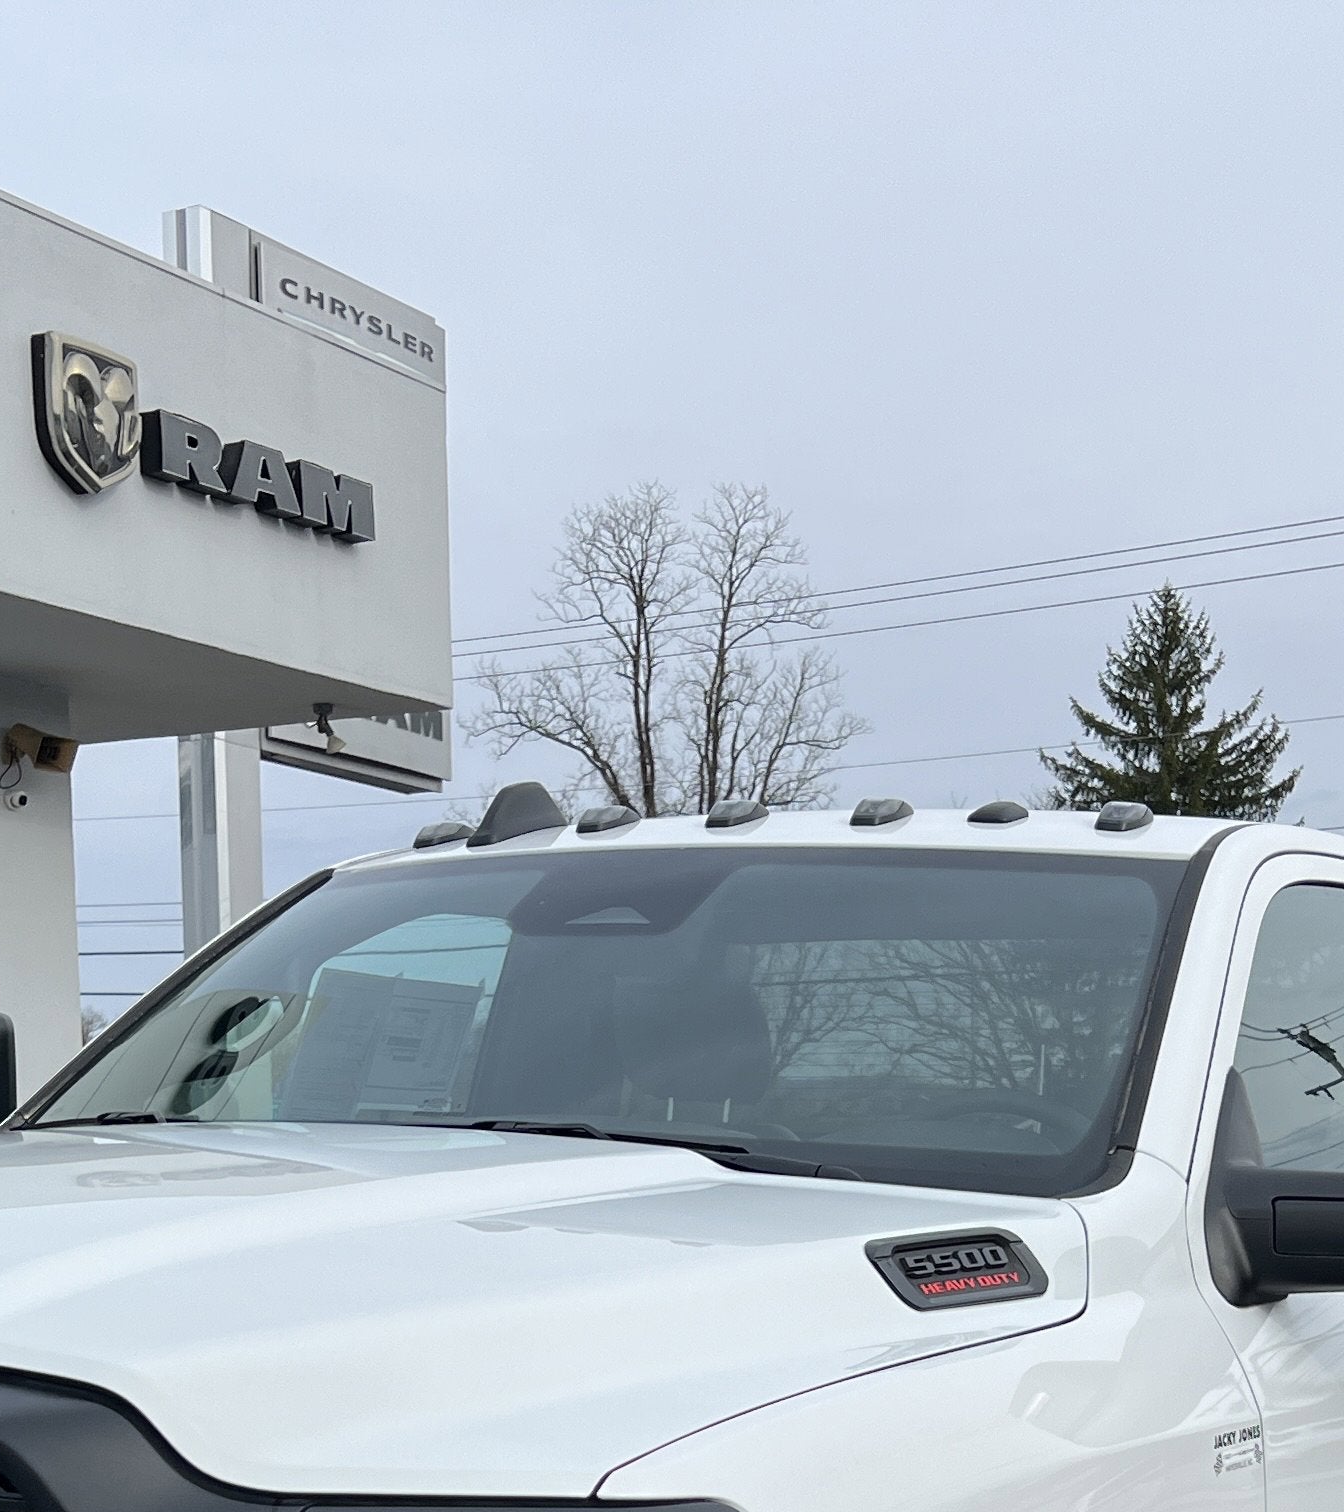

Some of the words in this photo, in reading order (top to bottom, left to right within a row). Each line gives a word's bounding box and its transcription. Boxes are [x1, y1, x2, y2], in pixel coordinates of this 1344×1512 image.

[279, 278, 434, 362] CHRYSLER
[144, 409, 376, 540] RAM
[906, 1246, 1008, 1278] 5500
[919, 1277, 976, 1295] HEAVY
[977, 1272, 1021, 1288] DUTY
[1214, 1431, 1236, 1449] JACKY
[1239, 1425, 1260, 1442] JONES
